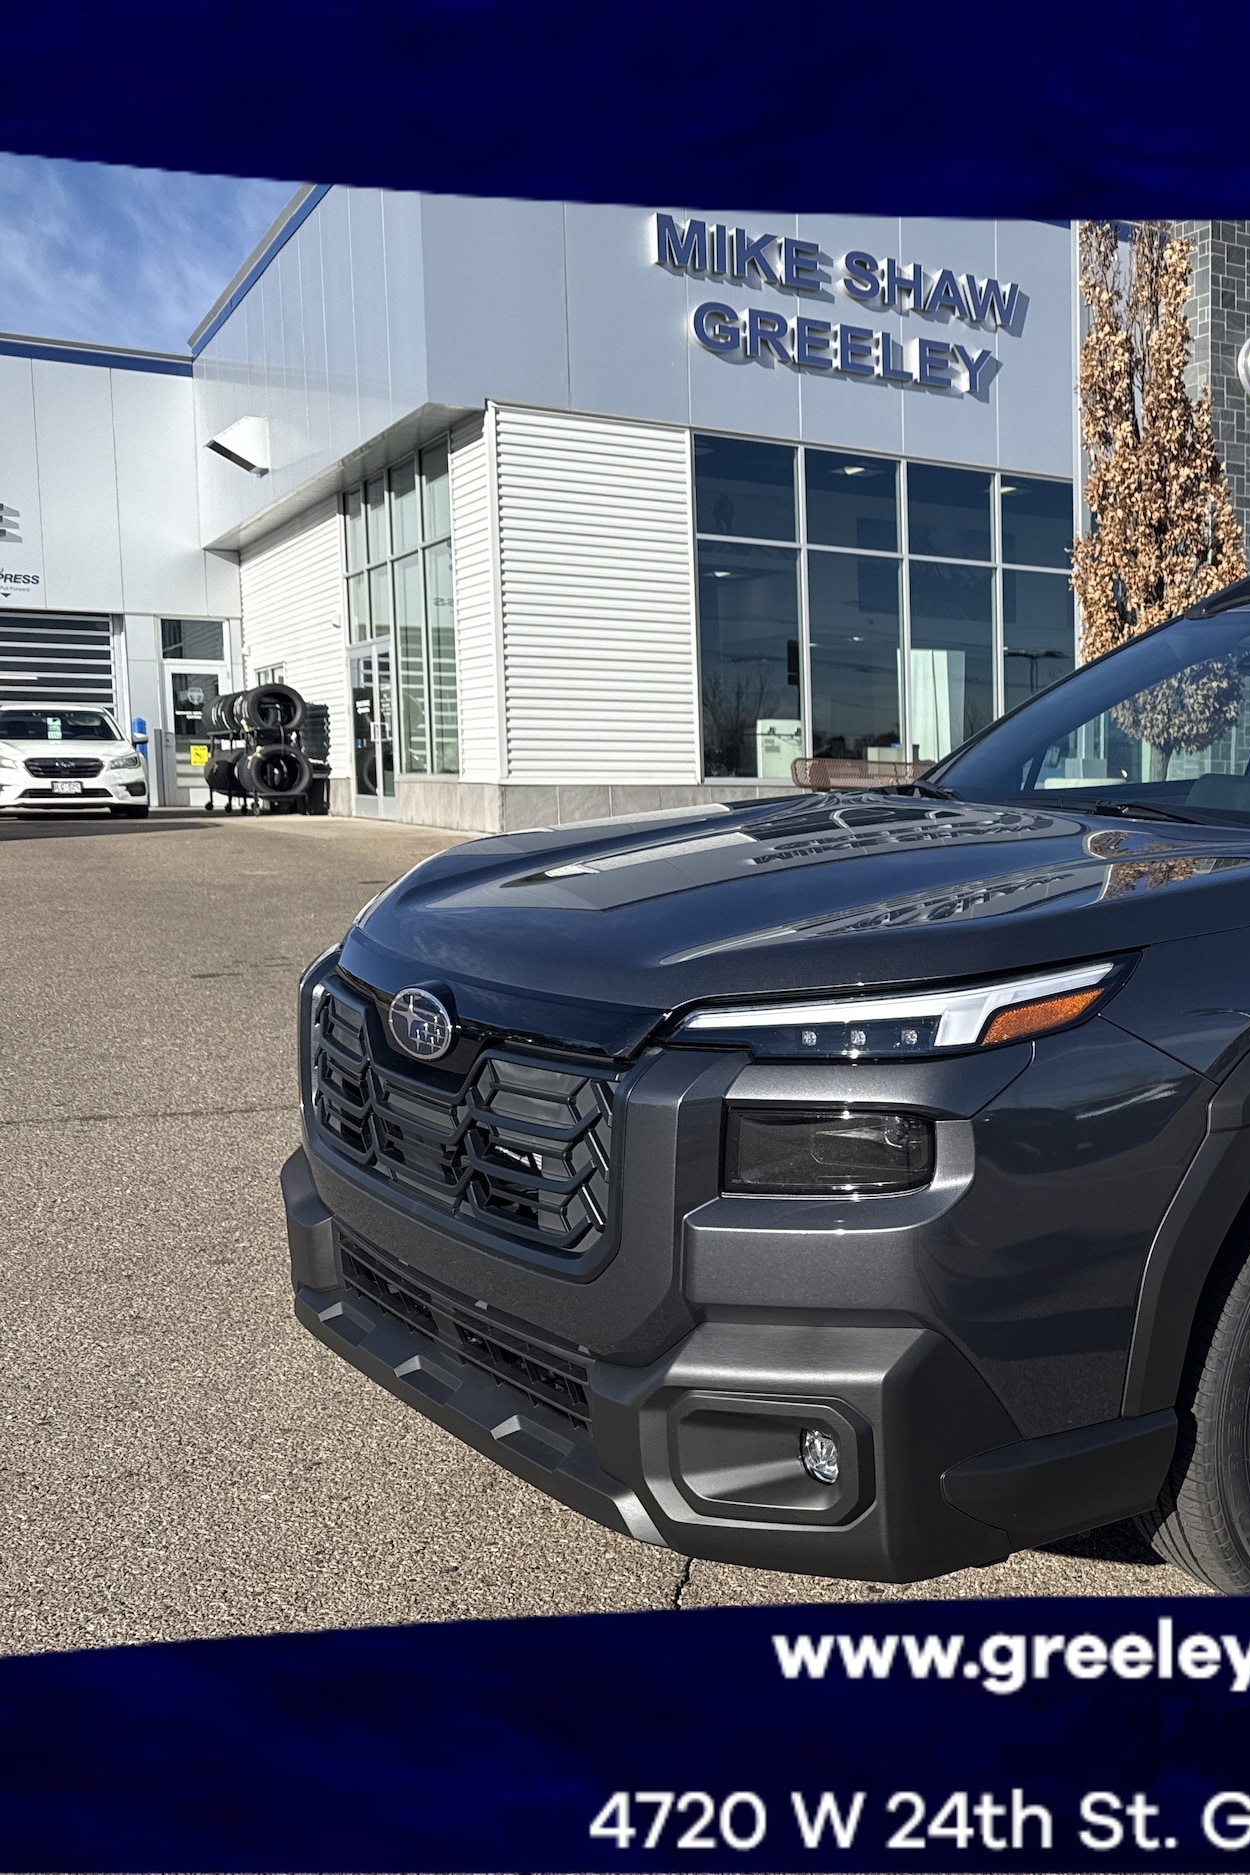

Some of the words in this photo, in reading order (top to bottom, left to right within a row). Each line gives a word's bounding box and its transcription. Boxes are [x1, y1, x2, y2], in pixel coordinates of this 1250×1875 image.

[655, 211, 822, 290] MIKE
[843, 250, 1020, 327] SHAW
[692, 301, 993, 393] GREELEY
